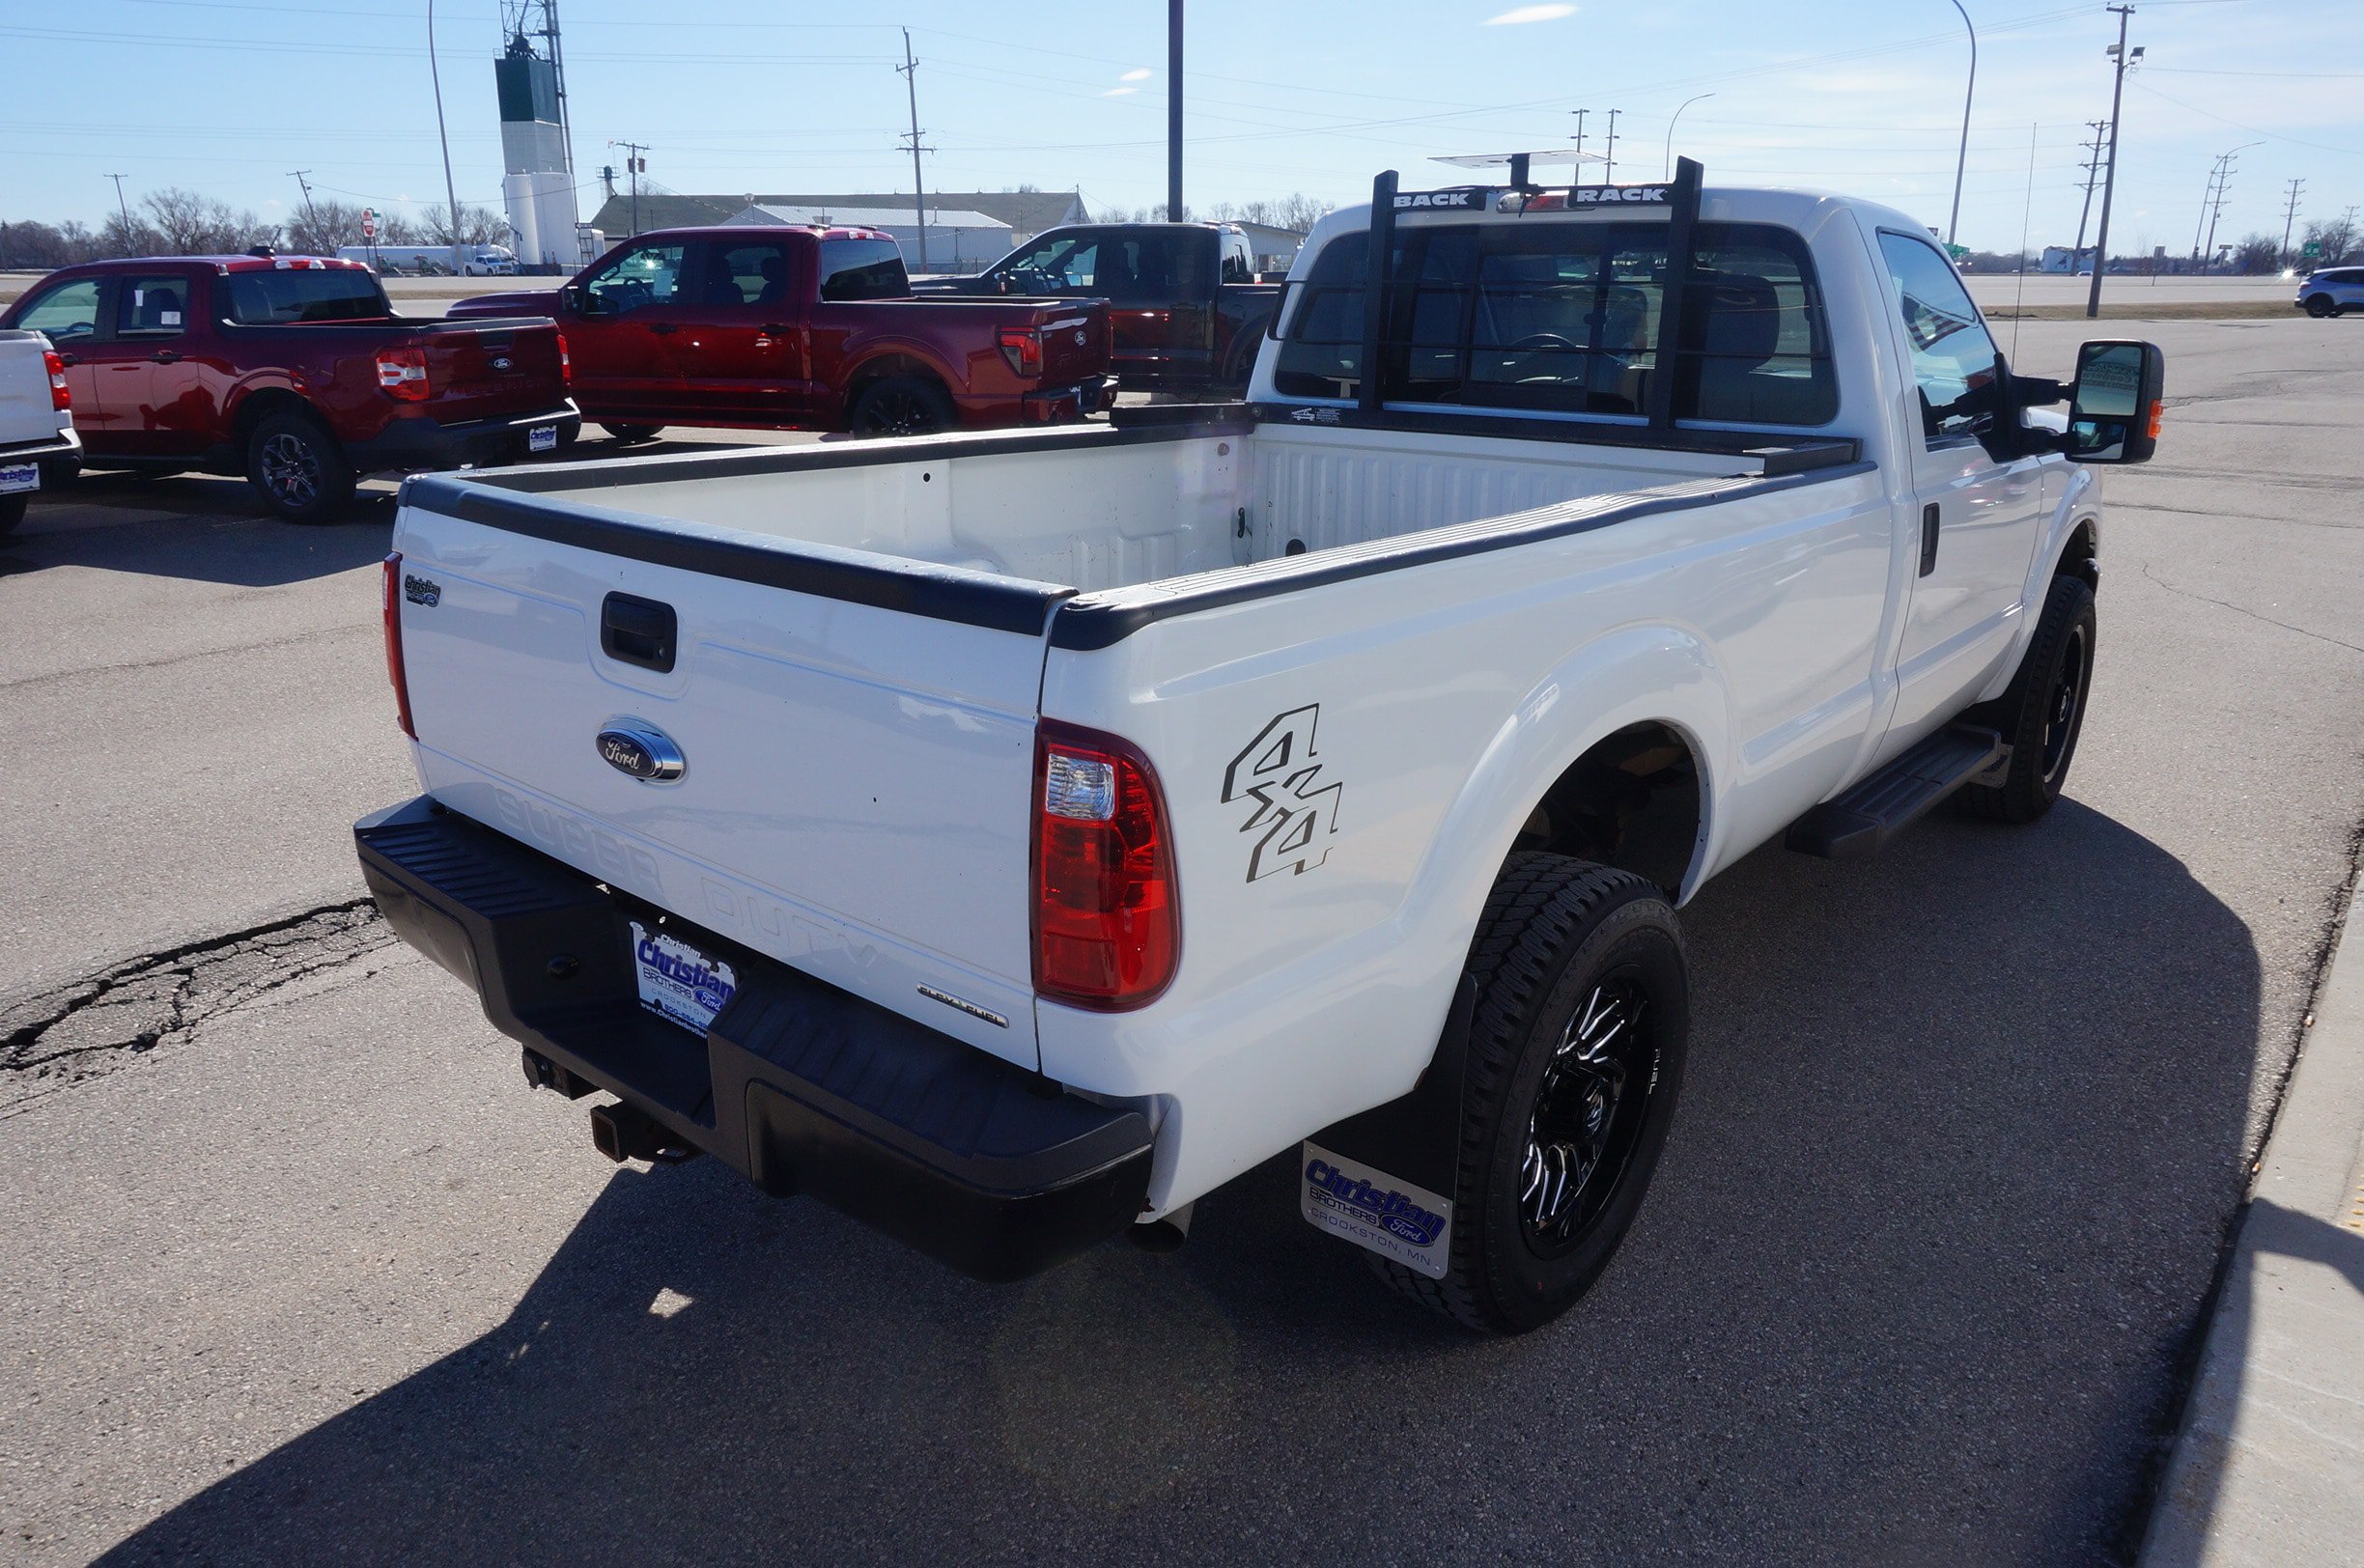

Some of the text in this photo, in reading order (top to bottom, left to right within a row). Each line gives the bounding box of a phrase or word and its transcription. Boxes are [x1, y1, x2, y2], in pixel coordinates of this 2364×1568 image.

[1393, 188, 1665, 208] BACK RACK
[605, 738, 641, 770] Ford
[494, 787, 879, 979] SUPER DUTY
[661, 934, 701, 959] Christian
[637, 938, 736, 1001] Christian
[643, 966, 692, 998] BROTHERS
[701, 991, 721, 1012] Ford
[919, 986, 1000, 1025] FLEX FUEL
[1305, 1159, 1447, 1241] Christian
[1309, 1187, 1378, 1226] BROTHERS
[1310, 1207, 1431, 1267] CROOKSTON, MN
[1390, 1218, 1421, 1243] Ford
